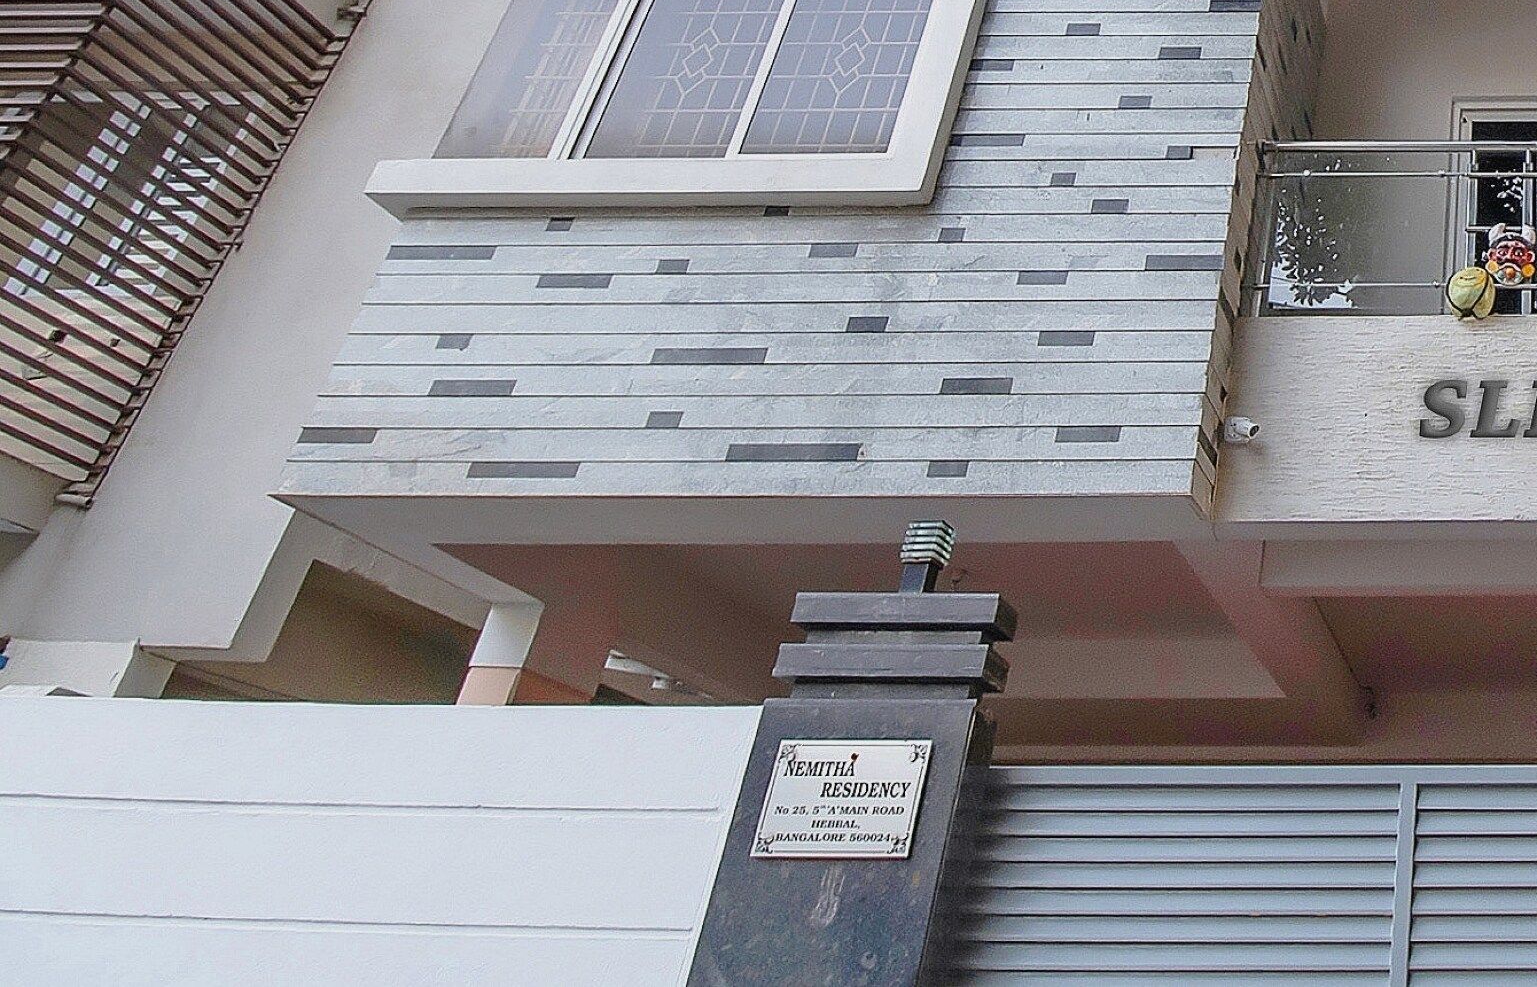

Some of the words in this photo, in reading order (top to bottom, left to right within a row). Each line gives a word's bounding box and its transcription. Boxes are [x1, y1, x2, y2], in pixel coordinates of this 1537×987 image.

[783, 761, 856, 777] NEMITHA
[820, 782, 912, 798] RESIDENCY
[872, 806, 905, 815] ROAD
[811, 820, 860, 830] HEBBAL,
[775, 833, 846, 842] BANGALORE
[849, 833, 891, 842] 560024
